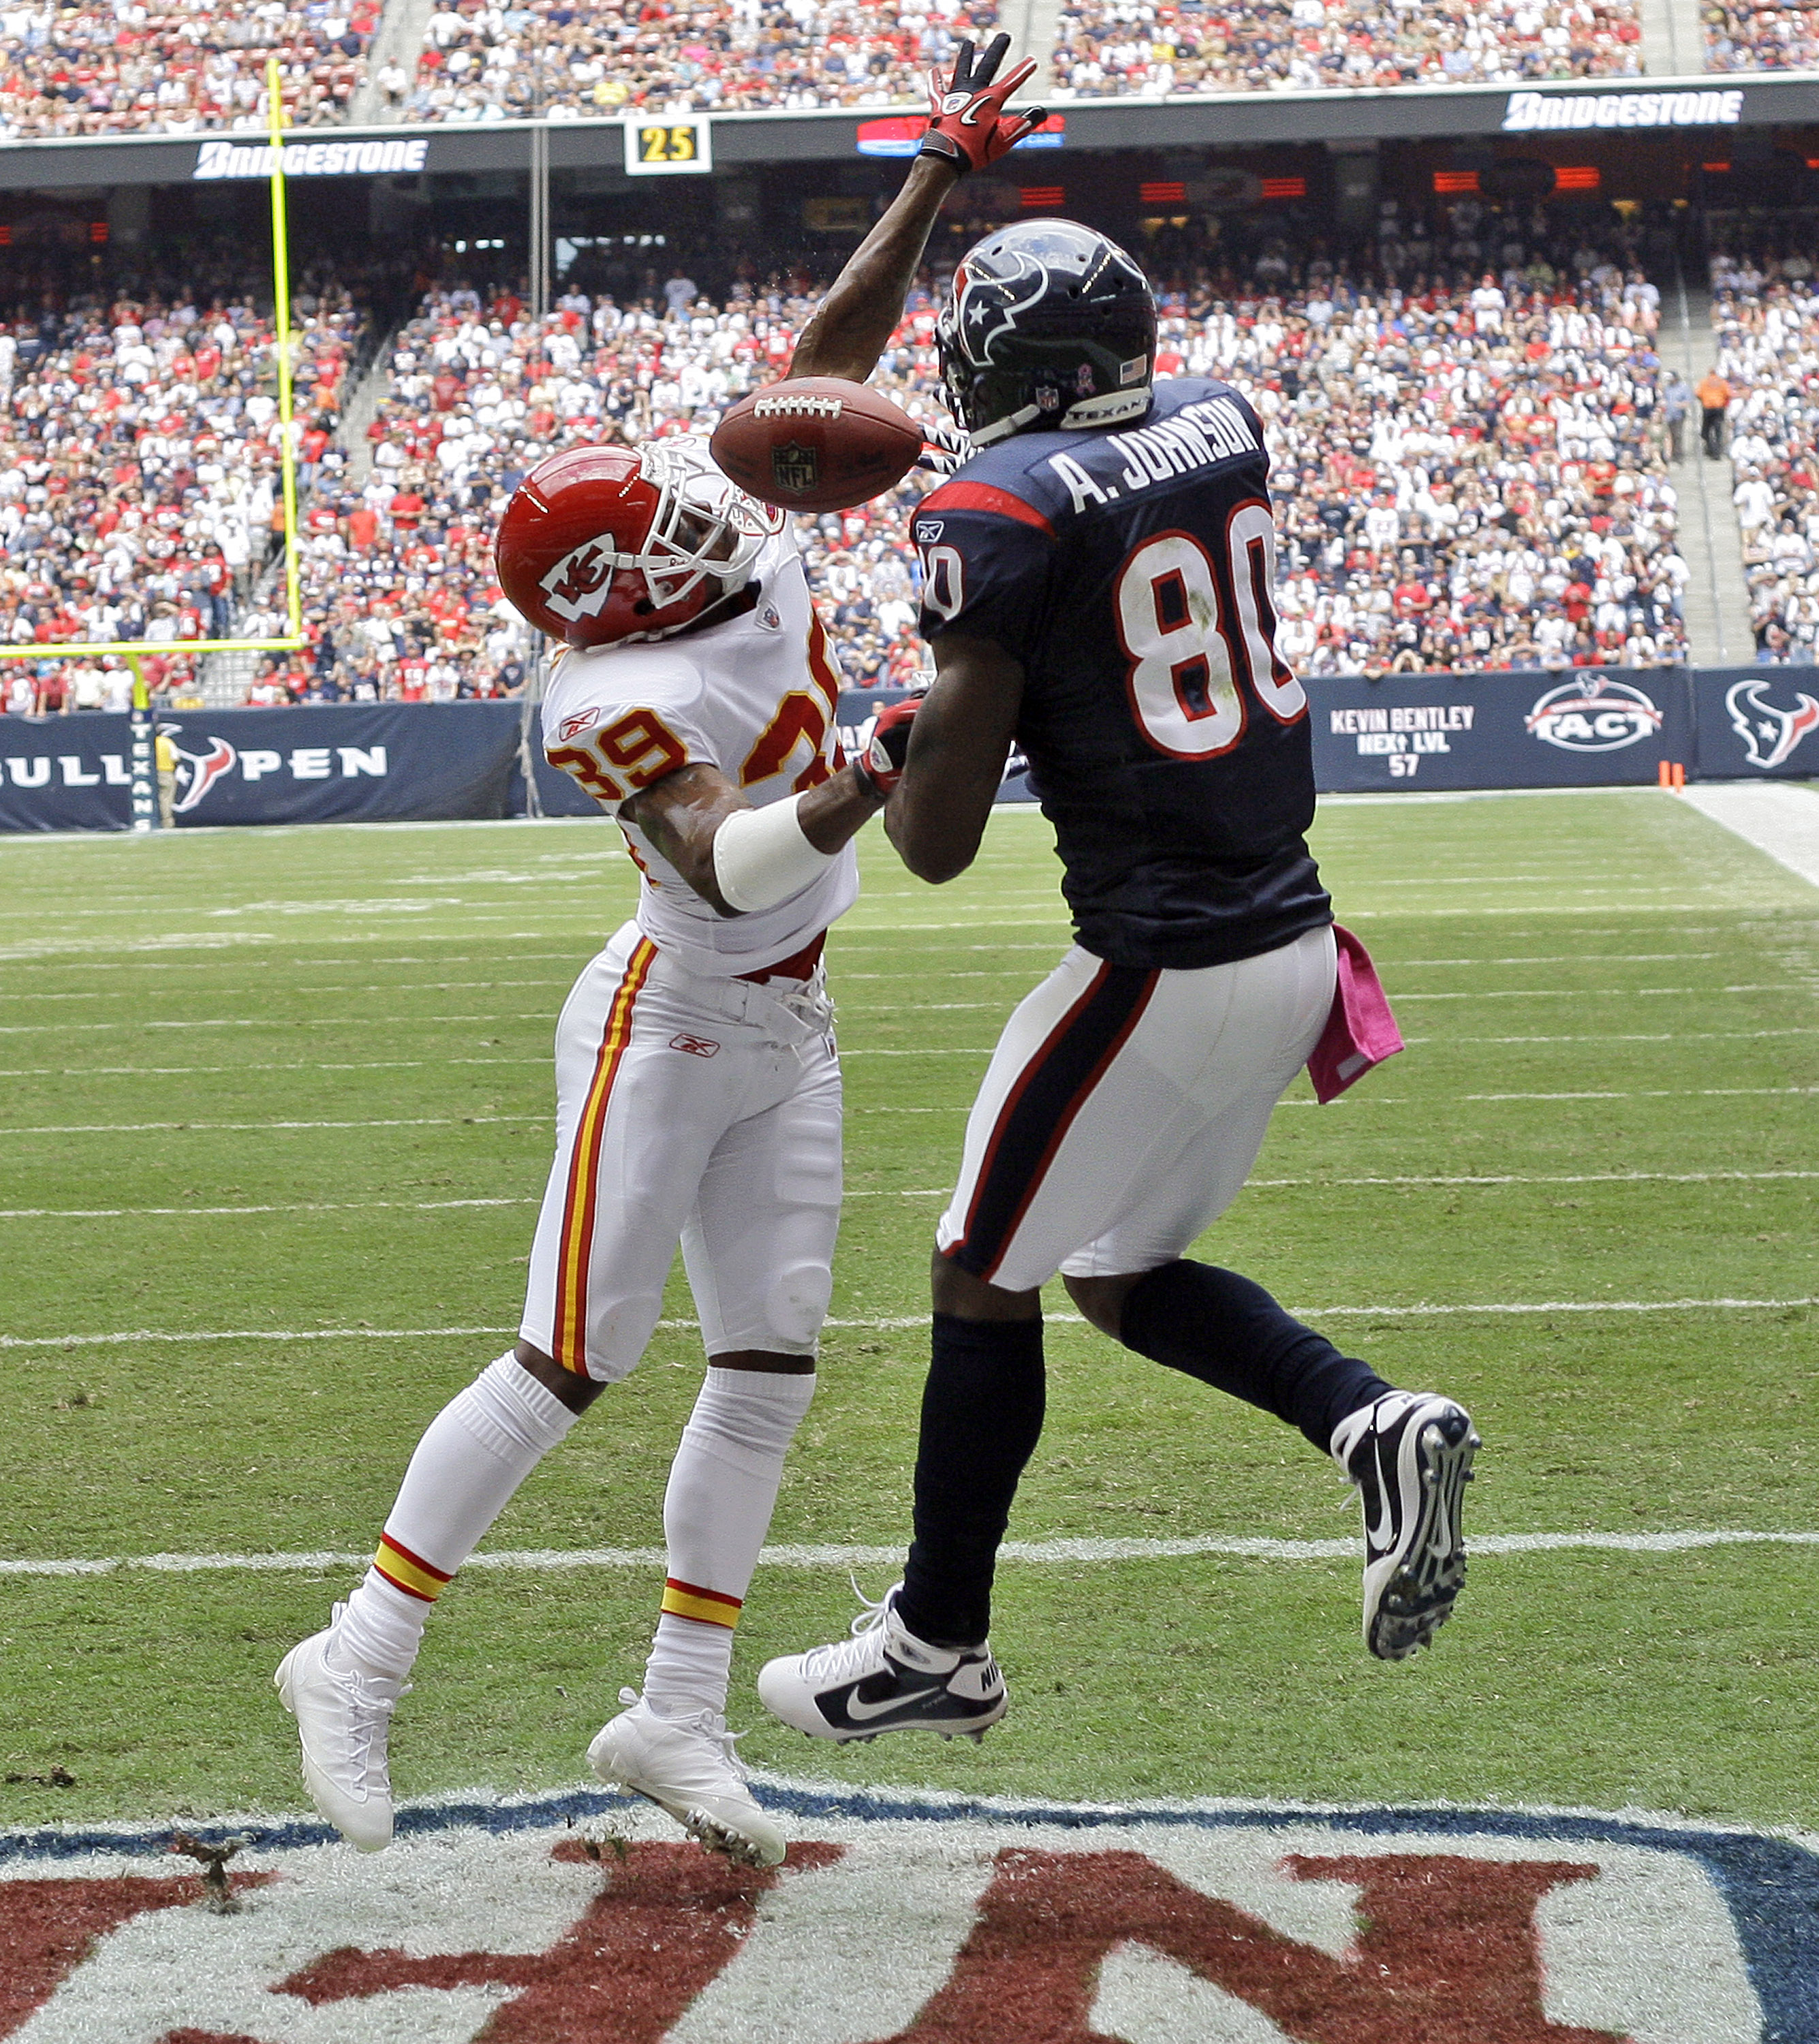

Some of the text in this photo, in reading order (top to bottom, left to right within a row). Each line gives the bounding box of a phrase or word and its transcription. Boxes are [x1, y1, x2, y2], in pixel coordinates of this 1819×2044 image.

[1502, 90, 1744, 131] BRIDGESTONE
[193, 140, 429, 180] BRIDGESTONE
[642, 126, 694, 161] 25
[776, 466, 814, 486] NFL
[1048, 397, 1260, 514] A. JOHNSON
[917, 544, 965, 622] 0
[1113, 497, 1309, 760] 80
[1331, 705, 1474, 734] KEVIN BENTLEY
[545, 707, 689, 801] 39
[1412, 731, 1452, 754] LVL
[0, 746, 387, 788] ULL PEN
[129, 723, 153, 833] TEXANS
[1388, 754, 1420, 777] 57
